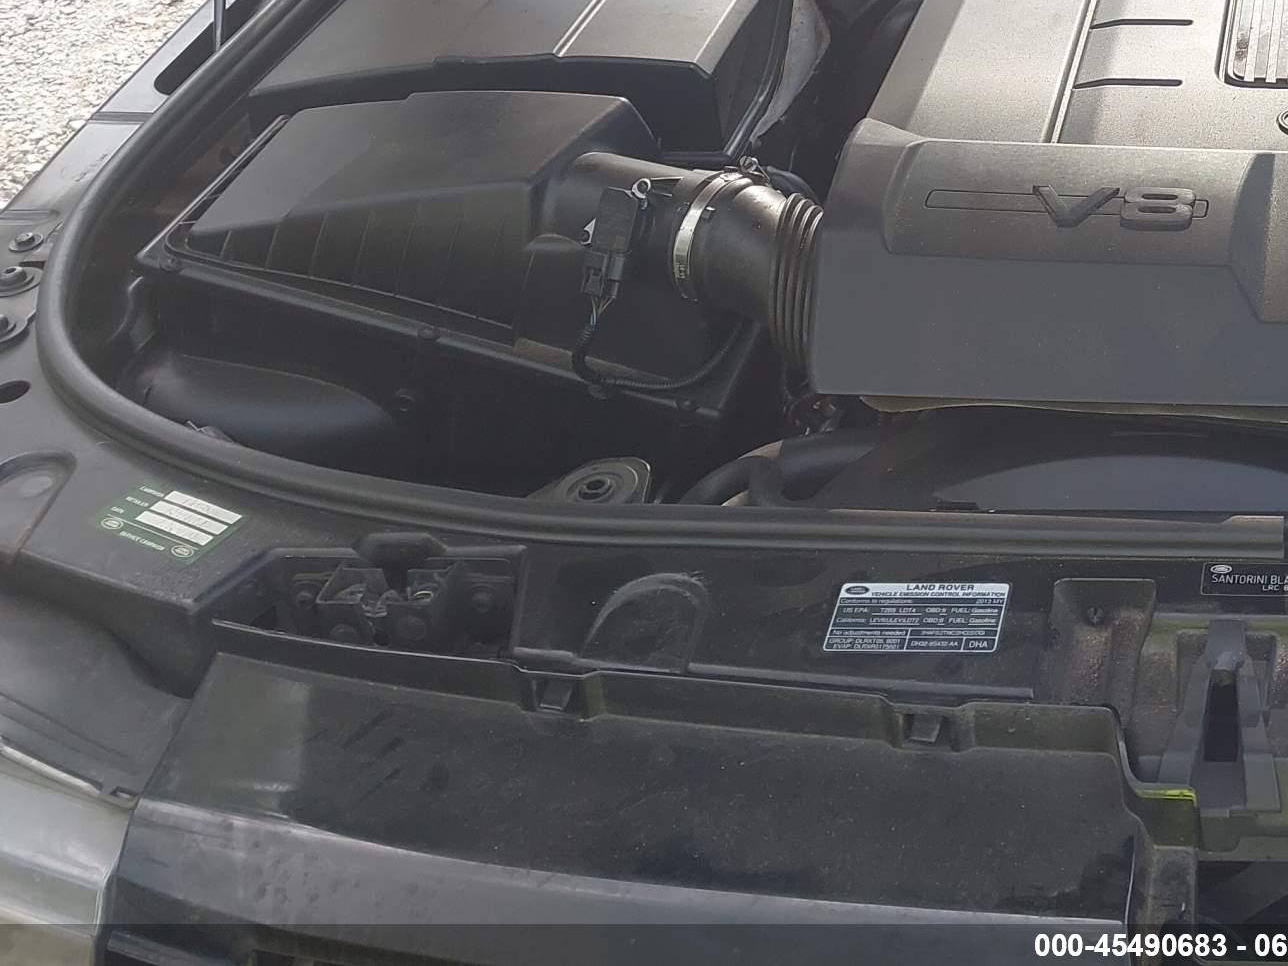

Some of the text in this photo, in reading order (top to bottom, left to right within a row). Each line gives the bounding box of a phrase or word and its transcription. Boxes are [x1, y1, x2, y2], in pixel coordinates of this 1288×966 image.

[1033, 185, 1195, 231] V8
[1210, 573, 1267, 584] SANTORINI
[968, 640, 988, 648] DHA
